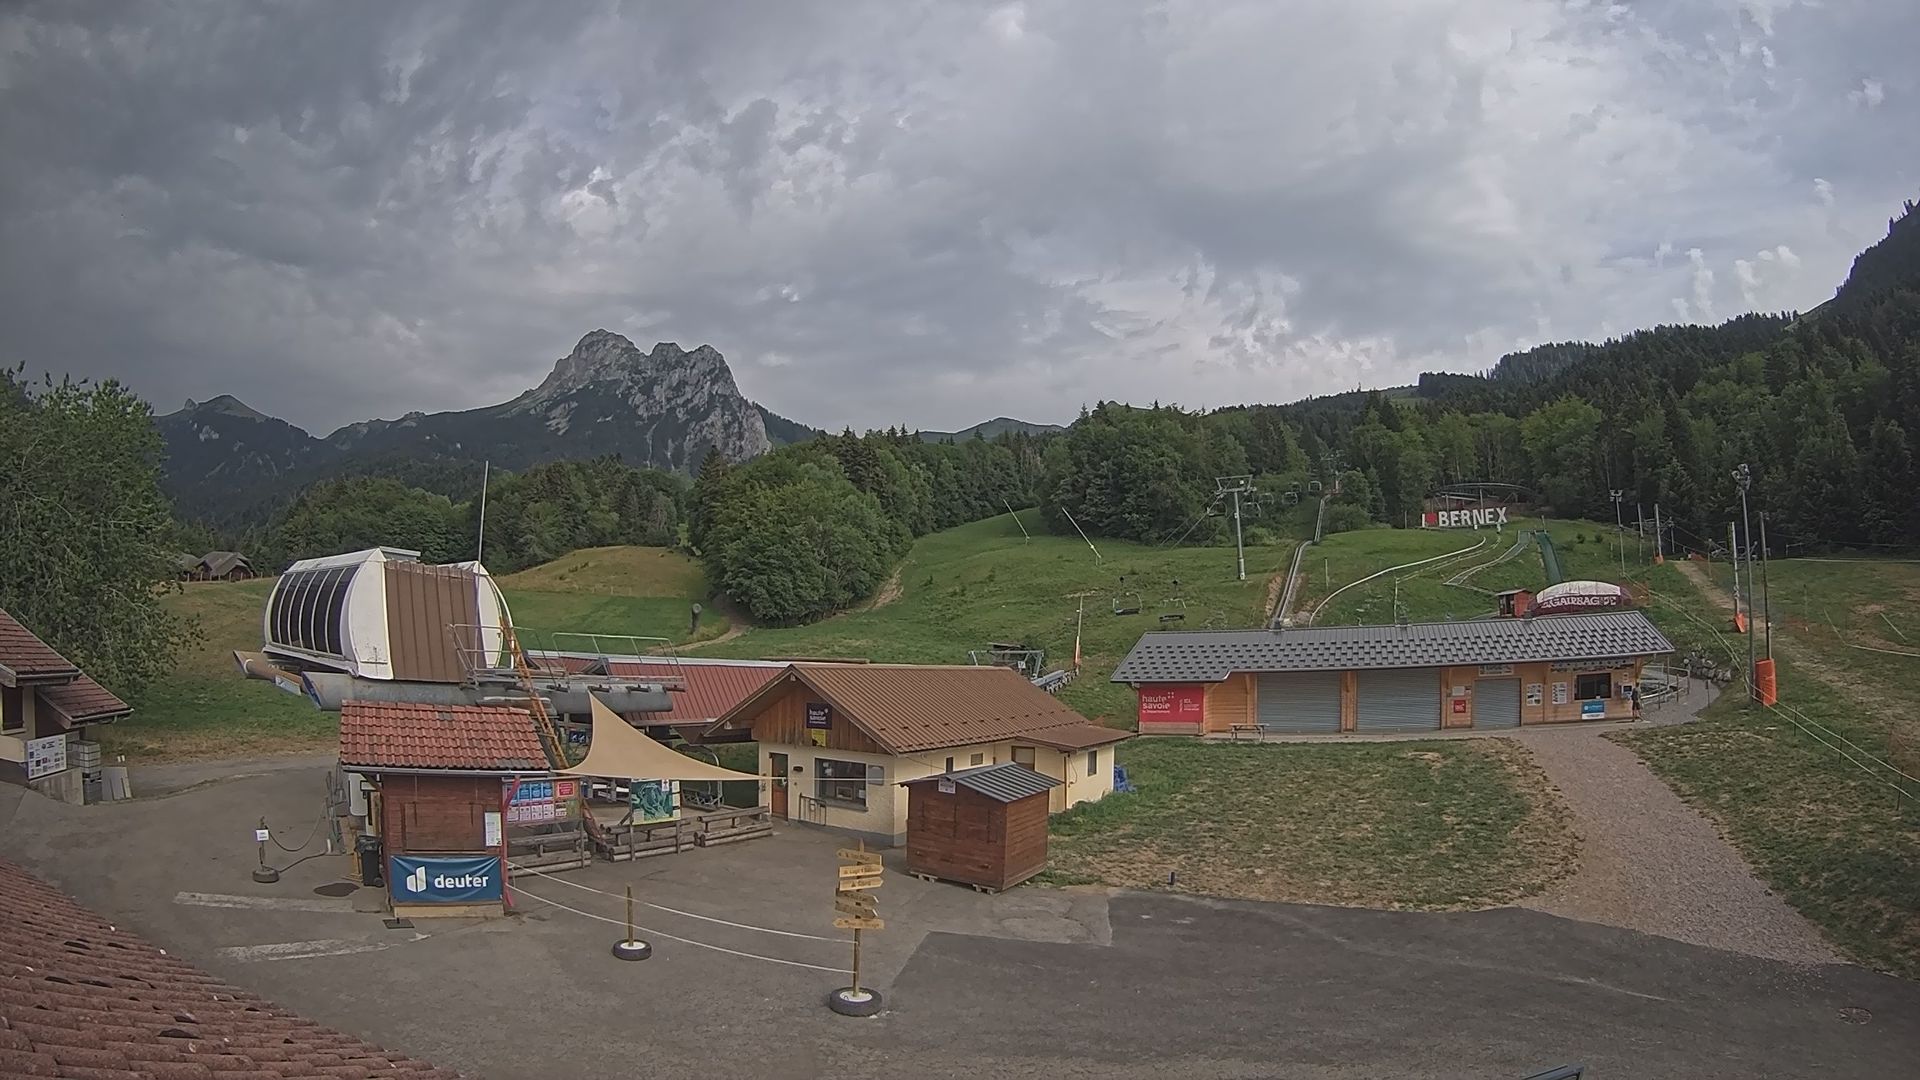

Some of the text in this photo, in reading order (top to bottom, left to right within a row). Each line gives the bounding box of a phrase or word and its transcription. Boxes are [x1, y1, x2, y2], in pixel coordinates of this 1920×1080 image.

[1438, 506, 1507, 527] BERNEX
[1142, 694, 1167, 703] haute
[434, 874, 489, 889] deuter
